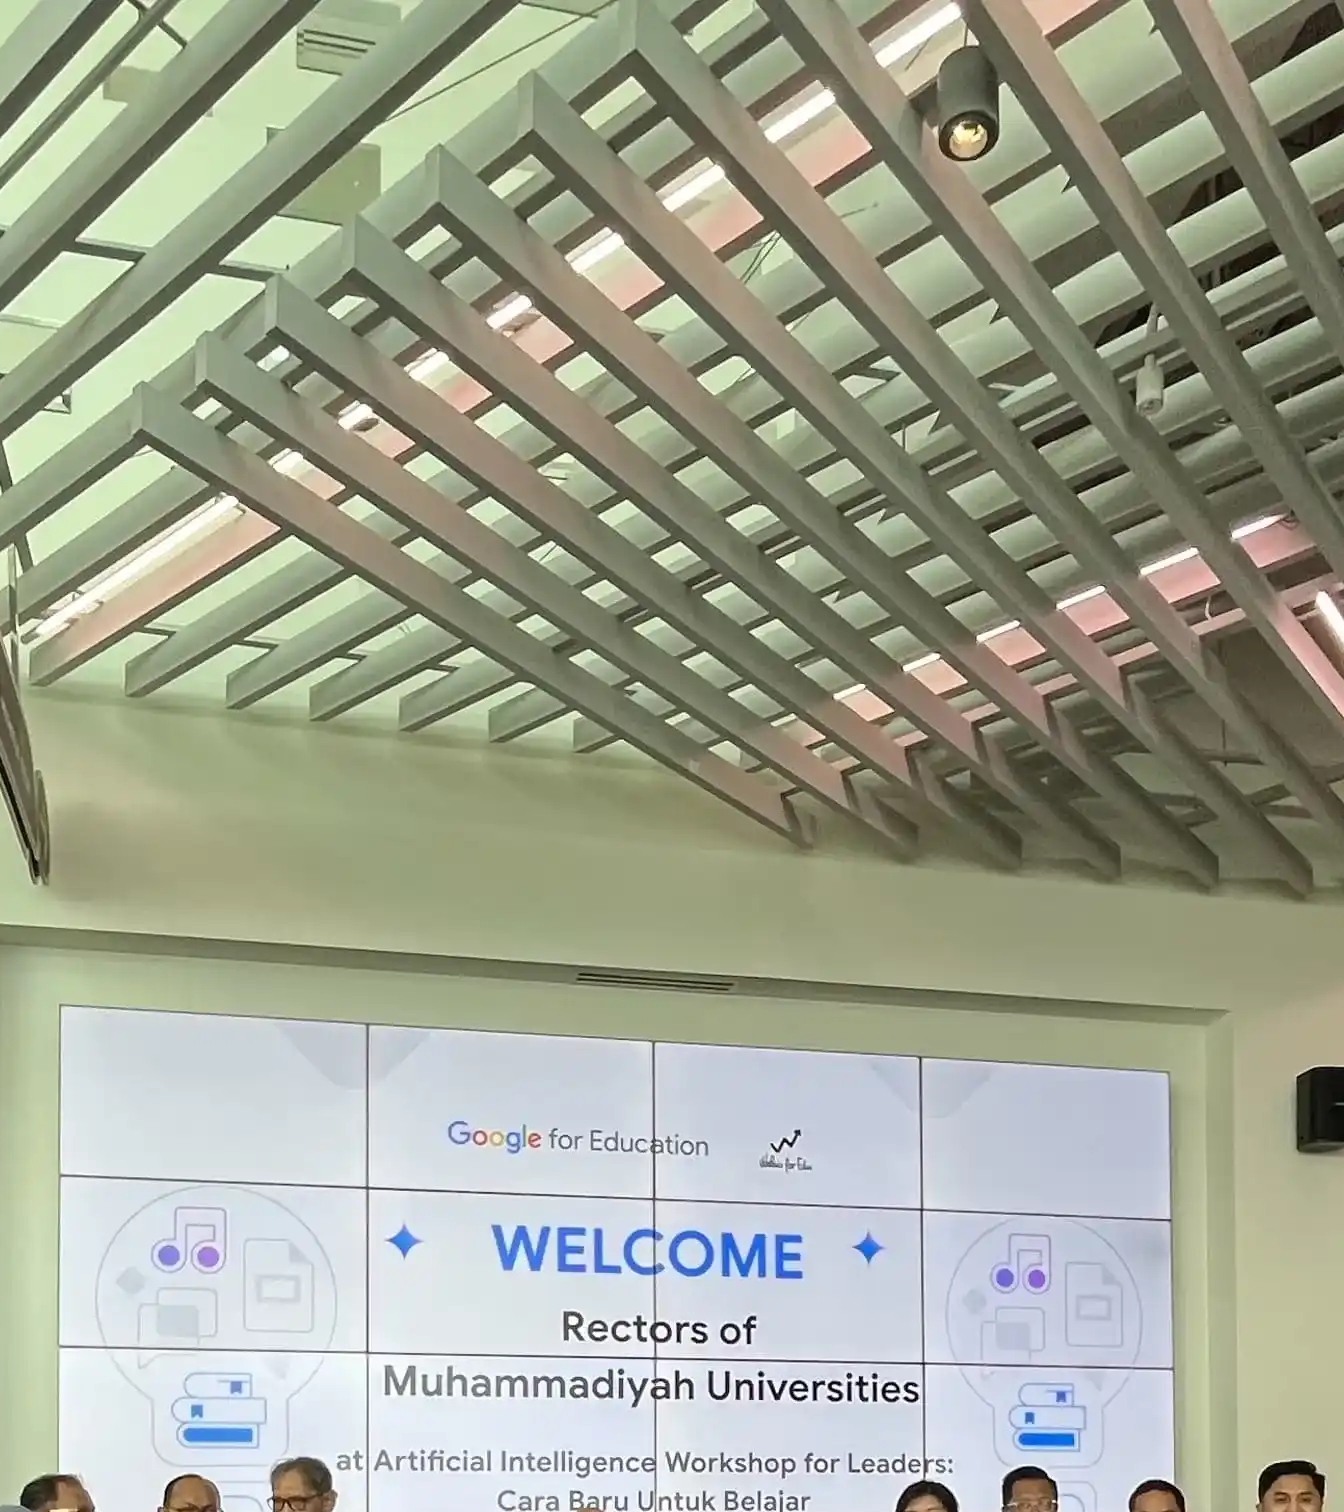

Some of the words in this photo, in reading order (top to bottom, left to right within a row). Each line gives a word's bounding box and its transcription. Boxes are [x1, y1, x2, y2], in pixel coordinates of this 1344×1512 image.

[448, 1121, 541, 1154] Google
[549, 1128, 583, 1149] for
[591, 1130, 708, 1156] Education
[492, 1225, 803, 1279] WELCOME
[563, 1311, 708, 1344] Rectors
[720, 1316, 756, 1344] of
[385, 1365, 694, 1408] Muhammadiyah
[708, 1371, 919, 1403] Universities
[337, 1451, 363, 1470] at
[374, 1449, 491, 1471] Artificial
[502, 1451, 656, 1478] Intelligence
[666, 1452, 796, 1479] Workshop
[804, 1453, 840, 1473] for
[849, 1453, 953, 1474] Leaders:
[498, 1490, 559, 1511] Cara
[570, 1490, 628, 1512] Baru
[638, 1491, 715, 1512] Untuk
